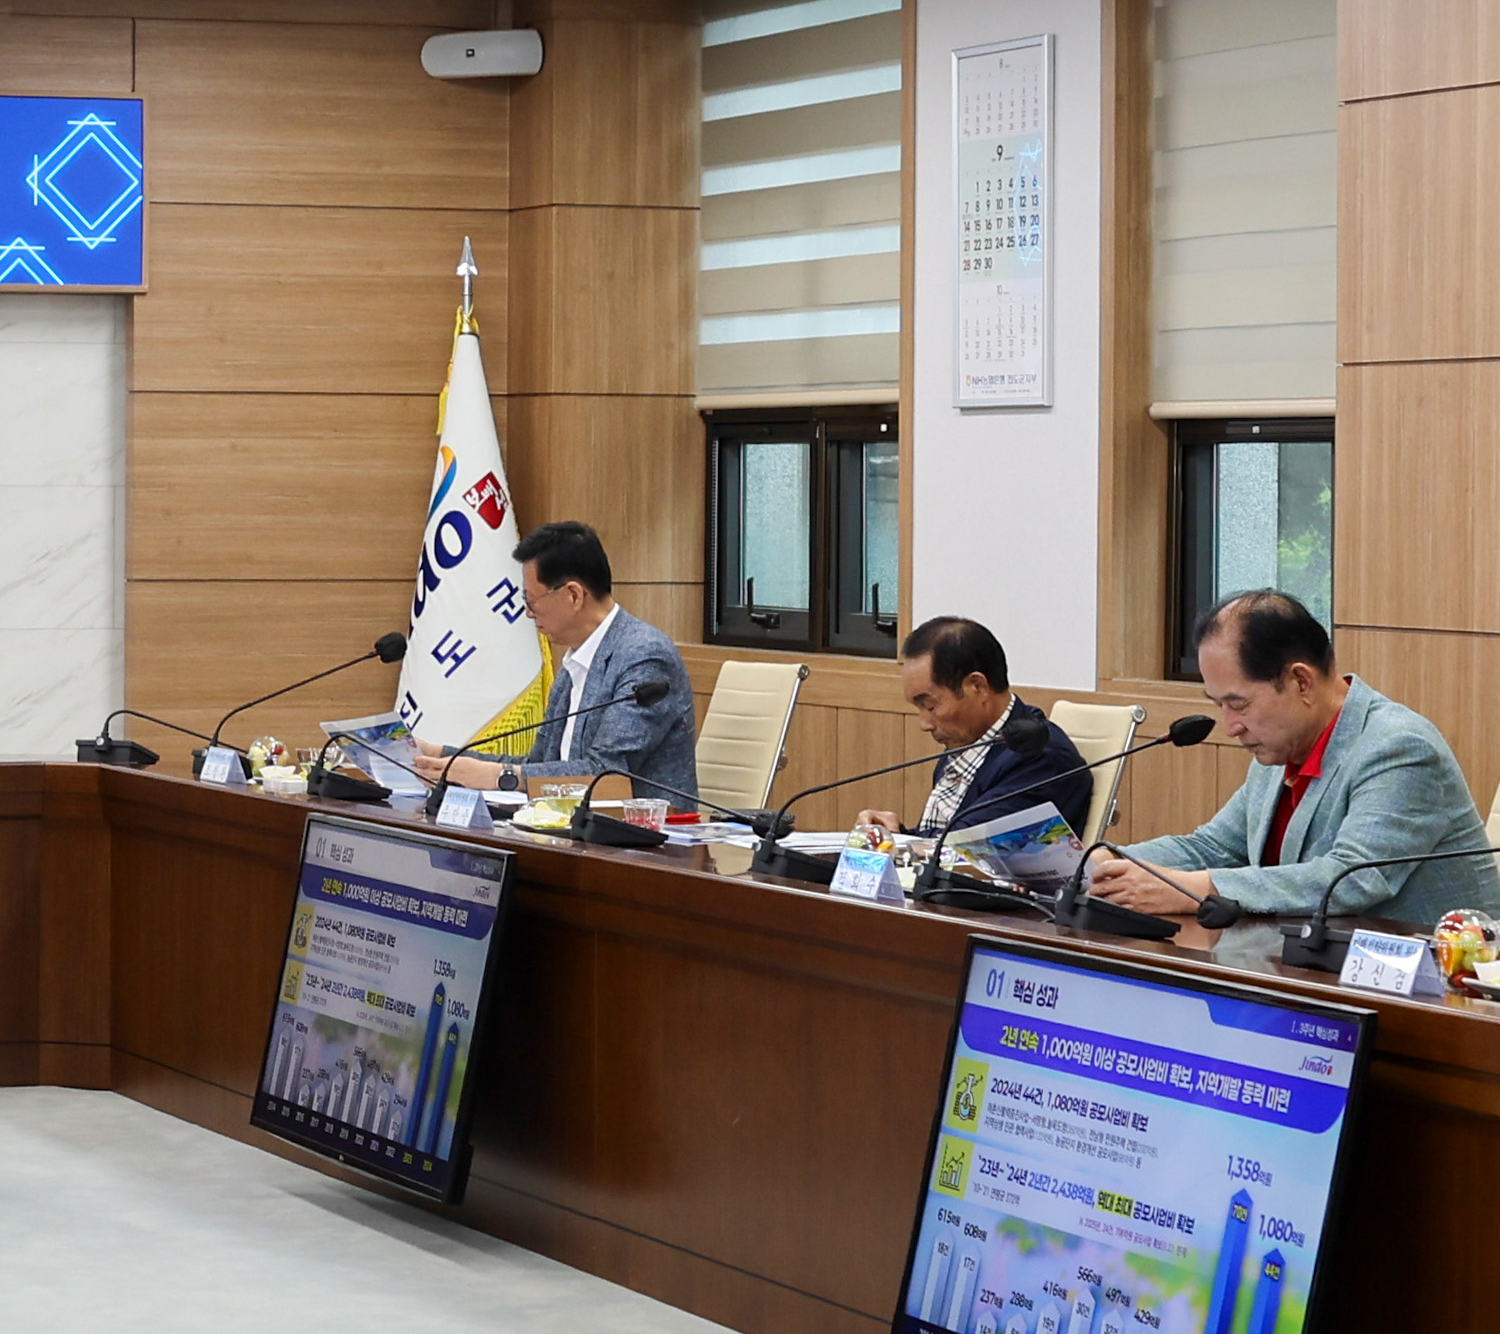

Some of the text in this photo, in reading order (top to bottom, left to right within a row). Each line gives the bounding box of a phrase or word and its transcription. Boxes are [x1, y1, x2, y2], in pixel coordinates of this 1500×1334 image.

[997, 145, 1003, 161] 9
[986, 968, 1005, 999] 01
[1013, 978, 1059, 1009] 핵심 성과
[1000, 1025, 1292, 1114] 2년 연속 1,000억원 이상 공모사업비 확보, 지역개발 동력 마련
[990, 1077, 1022, 1100] 2024년
[1022, 1087, 1044, 1109] 44건,
[1047, 1091, 1089, 1117] 1,080억원
[1090, 1101, 1131, 1128] 공모사업비
[1028, 1172, 1051, 1193] 2년간
[1227, 1154, 1273, 1187] 1,358억원
[1259, 1214, 1306, 1248] 1,080억원
